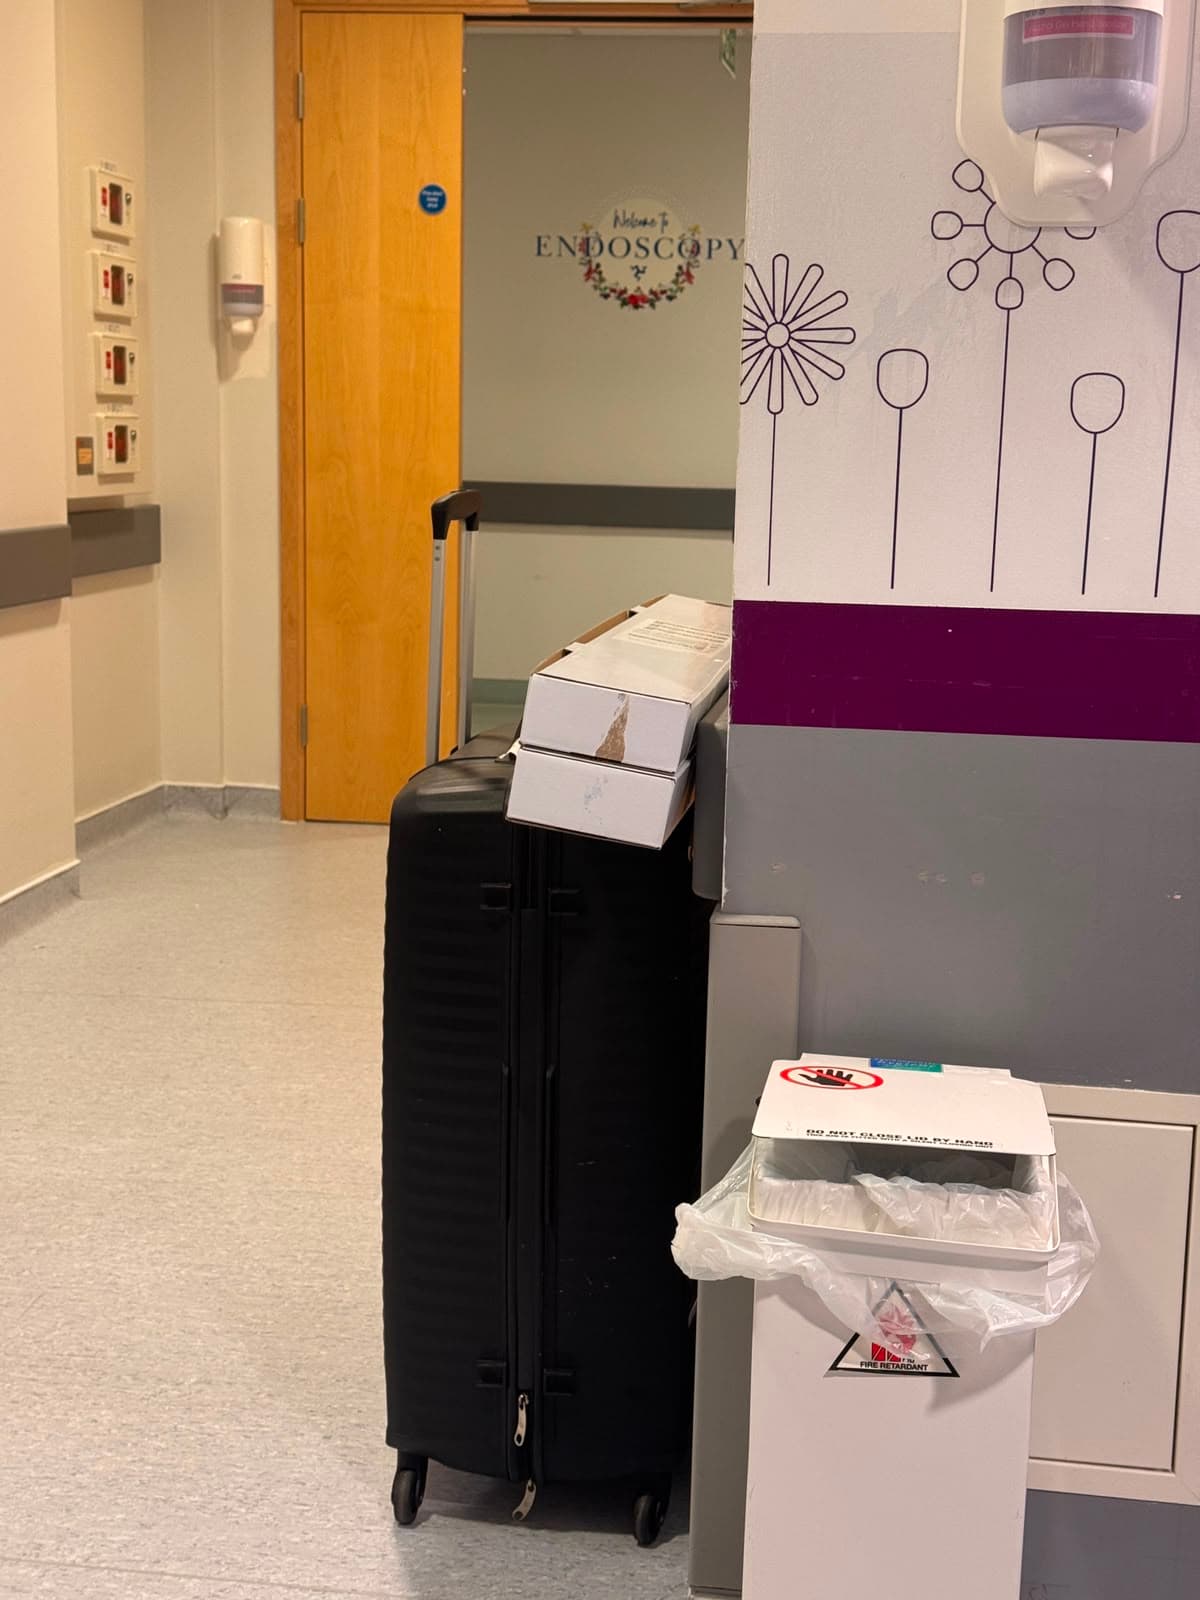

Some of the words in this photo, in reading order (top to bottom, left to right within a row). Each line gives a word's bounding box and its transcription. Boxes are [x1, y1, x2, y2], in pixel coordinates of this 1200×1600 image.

[613, 209, 655, 229] Welcome
[536, 235, 745, 260] ENDOSCOPY
[860, 1361, 878, 1369] FIRE
[880, 1363, 929, 1371] RETARDANT
